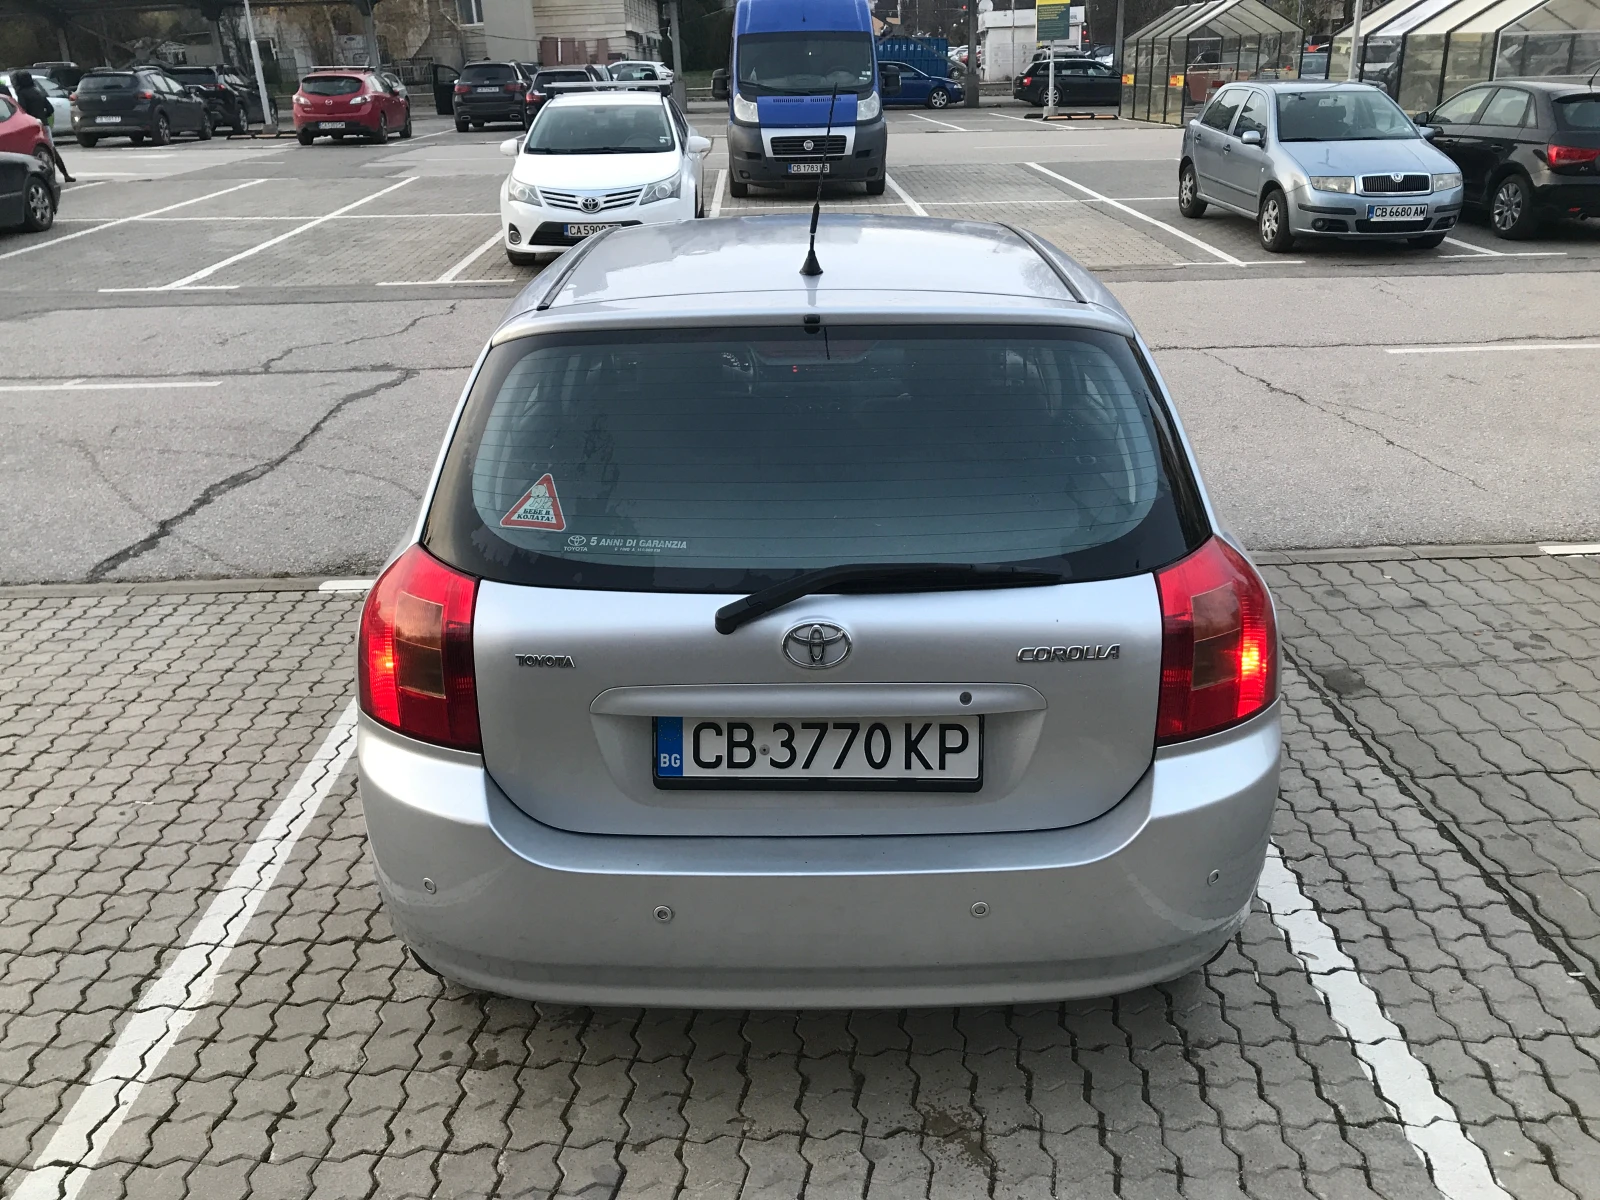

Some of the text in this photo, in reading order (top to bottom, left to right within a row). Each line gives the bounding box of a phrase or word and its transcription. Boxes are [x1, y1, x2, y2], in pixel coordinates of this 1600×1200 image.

[792, 164, 801, 172] CB
[803, 164, 818, 172] 1783
[1374, 206, 1426, 218] CB 6680 AM
[569, 225, 582, 236] CA
[516, 513, 554, 522] КОЛАТА!
[589, 536, 598, 546] 5
[625, 539, 637, 547] DI
[638, 539, 687, 549] GARANZIA
[1016, 643, 1120, 662] COROLLA
[515, 653, 576, 668] TOYOTA
[692, 722, 969, 770] CB 3770 KP
[660, 753, 681, 768] BG
